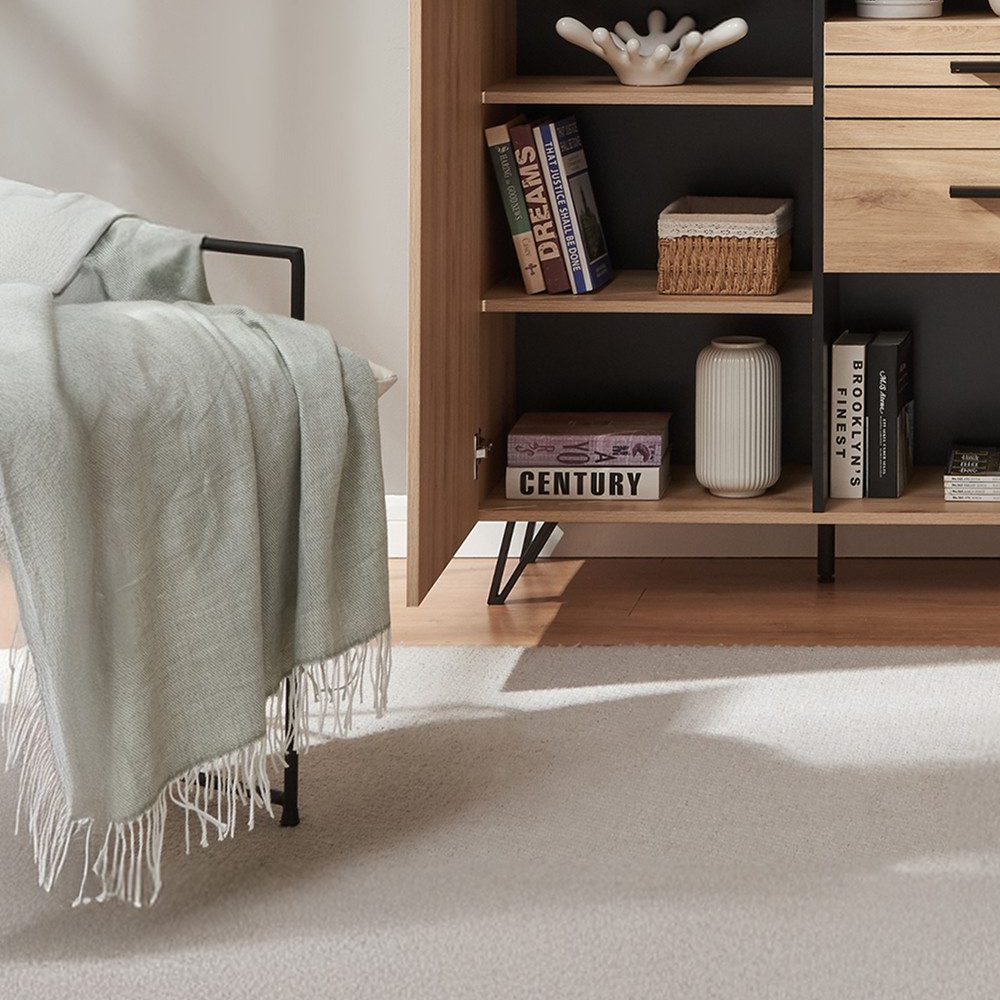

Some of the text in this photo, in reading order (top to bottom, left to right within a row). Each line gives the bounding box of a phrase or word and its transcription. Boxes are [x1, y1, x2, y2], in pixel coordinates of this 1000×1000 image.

[515, 146, 560, 261] DREAMS
[544, 141, 581, 272] THAT JUSTICE SHALL BE DONE
[836, 387, 848, 459] FINEST
[850, 360, 863, 487] BROOKLYN'S
[519, 470, 641, 496] CENTURY
